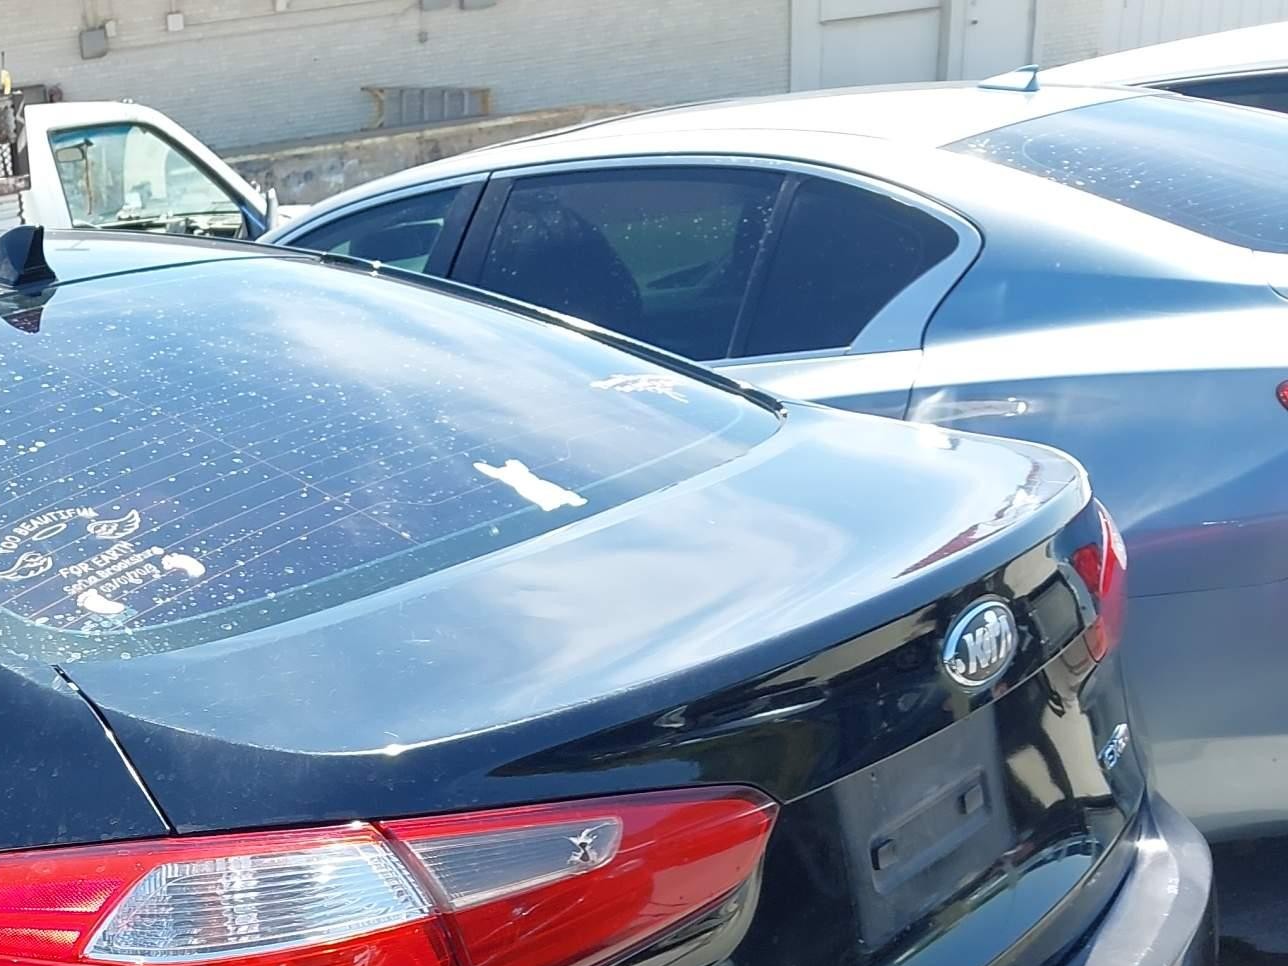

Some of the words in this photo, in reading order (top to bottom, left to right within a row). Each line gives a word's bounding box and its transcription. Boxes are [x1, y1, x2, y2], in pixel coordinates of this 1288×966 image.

[12, 507, 100, 536] BEAUTIFUL
[58, 562, 94, 579] FOR
[92, 540, 134, 567] EARTH
[96, 547, 161, 580] Brookshir
[962, 614, 1013, 675] KIA
